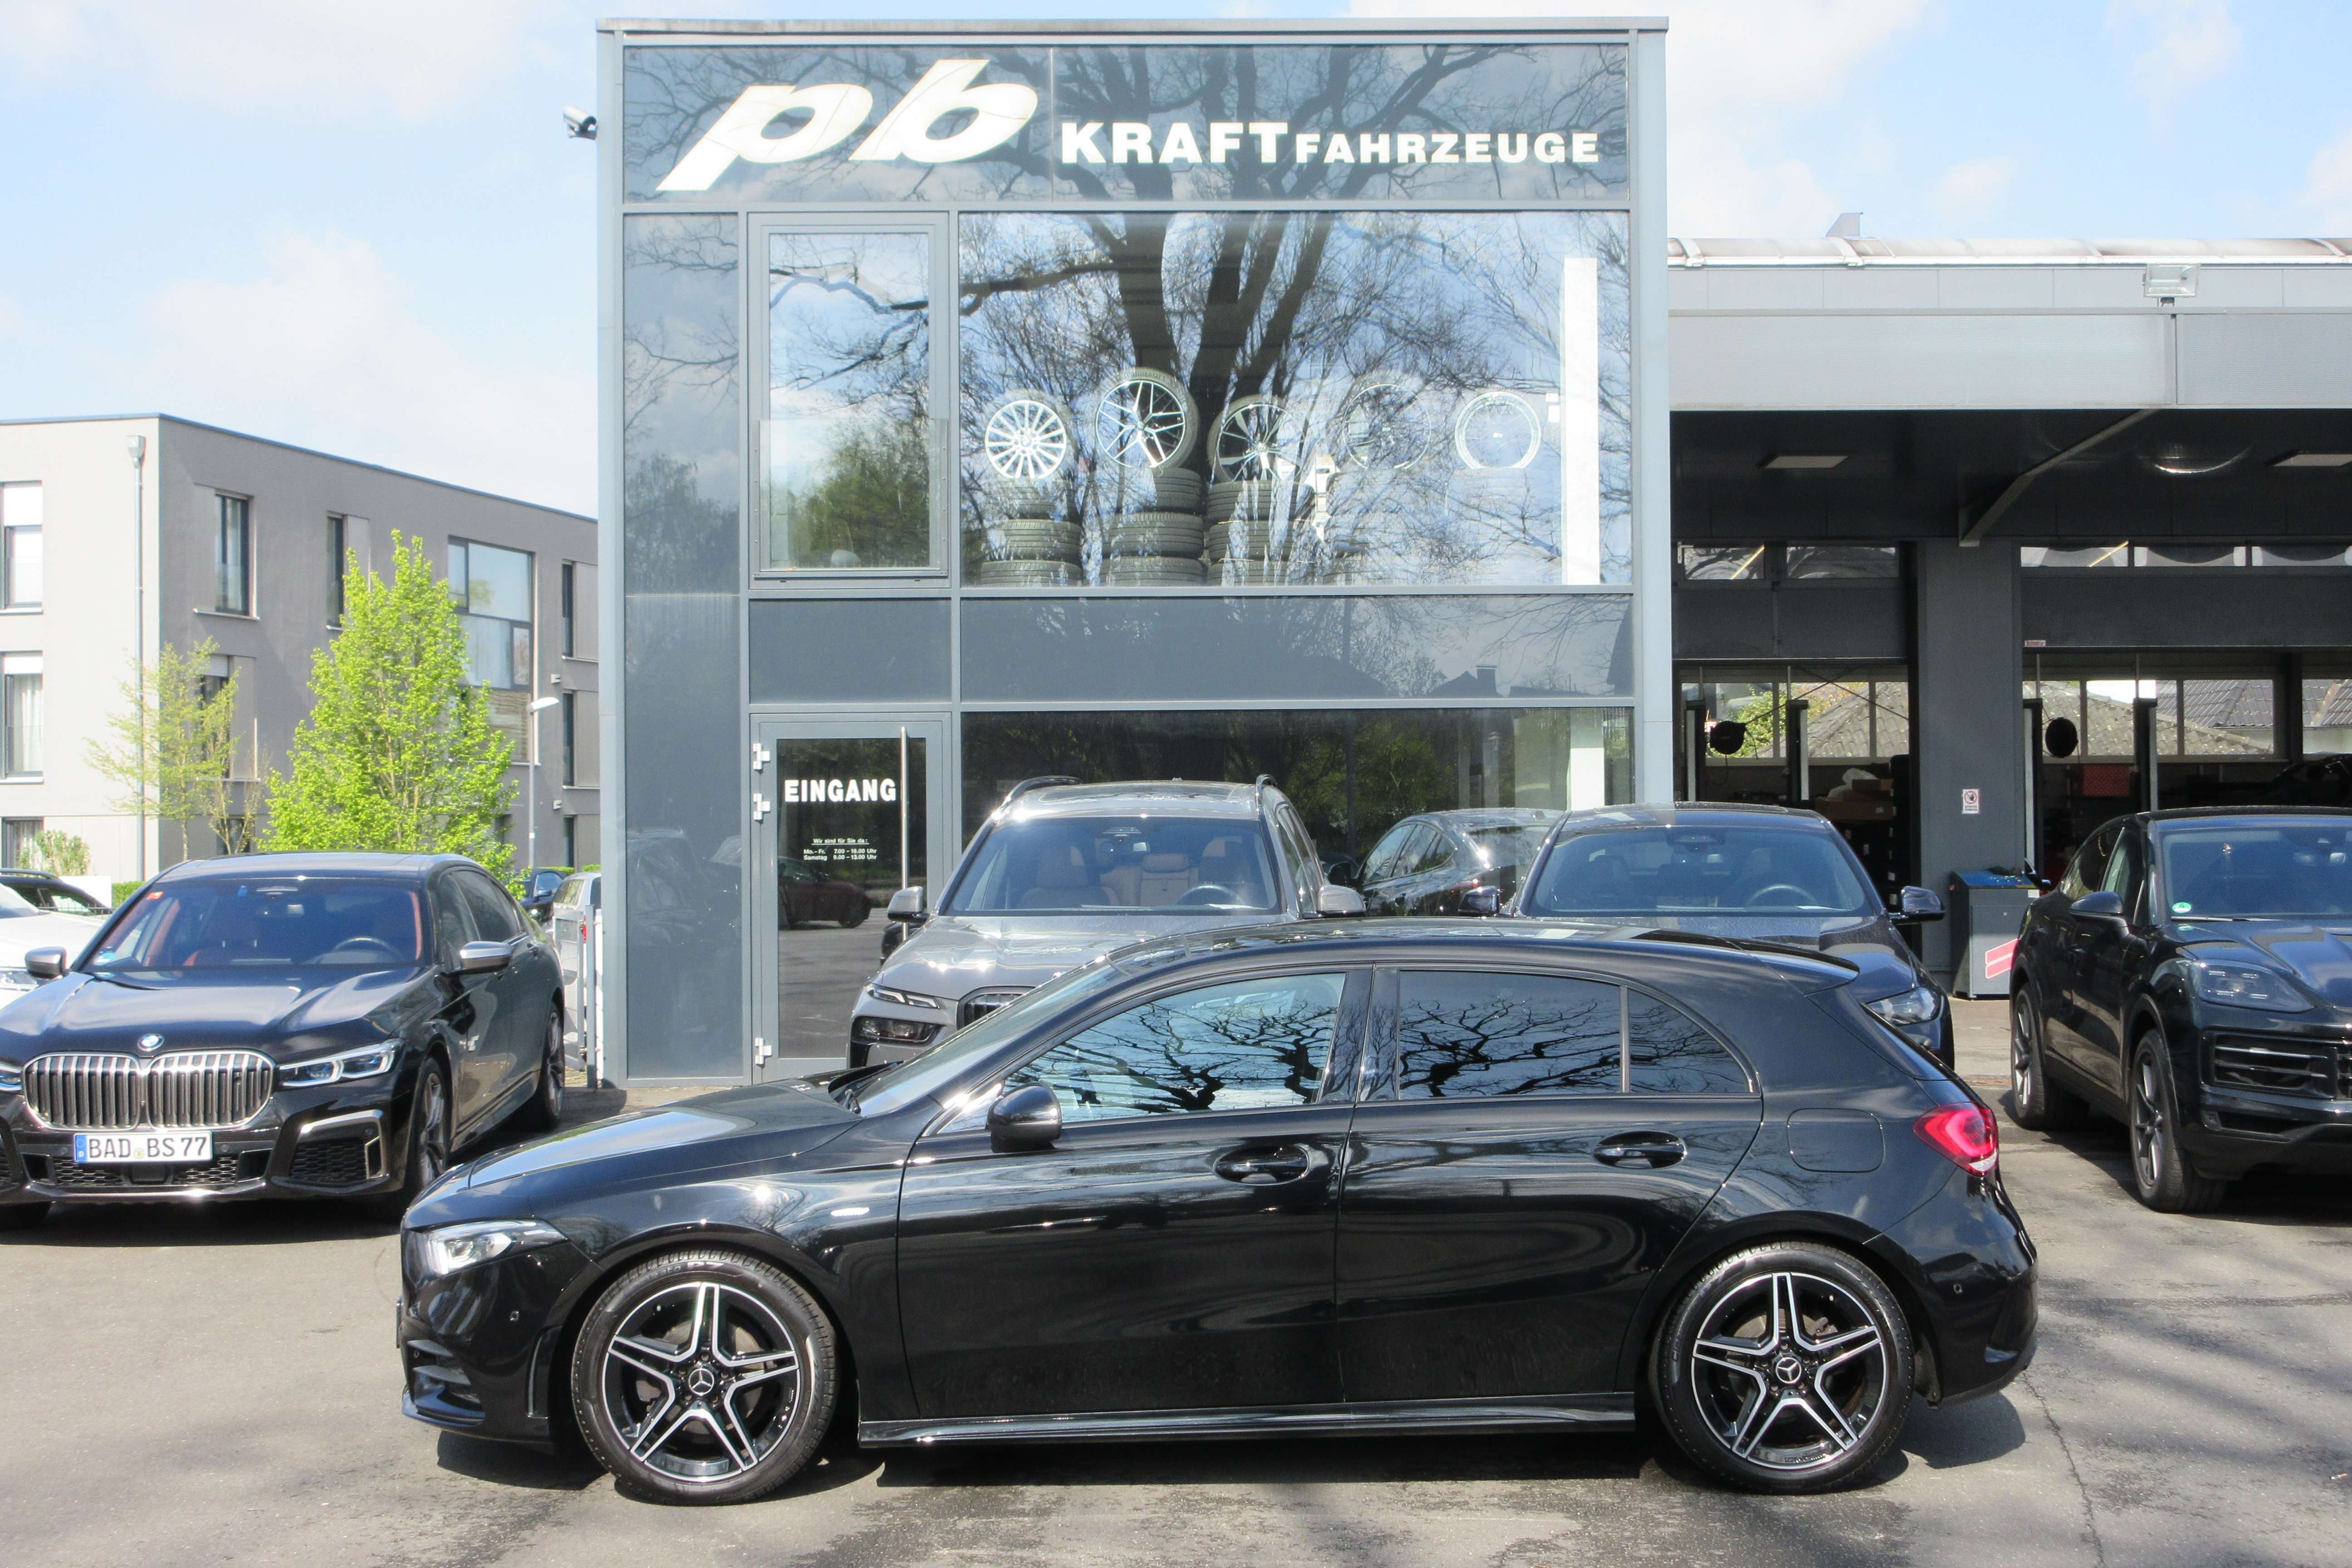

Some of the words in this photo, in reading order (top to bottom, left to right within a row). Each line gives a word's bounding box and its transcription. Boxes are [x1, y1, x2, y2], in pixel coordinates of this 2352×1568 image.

[656, 59, 1038, 191] pb
[784, 779, 897, 802] EINGANG
[89, 1138, 132, 1158] BAD
